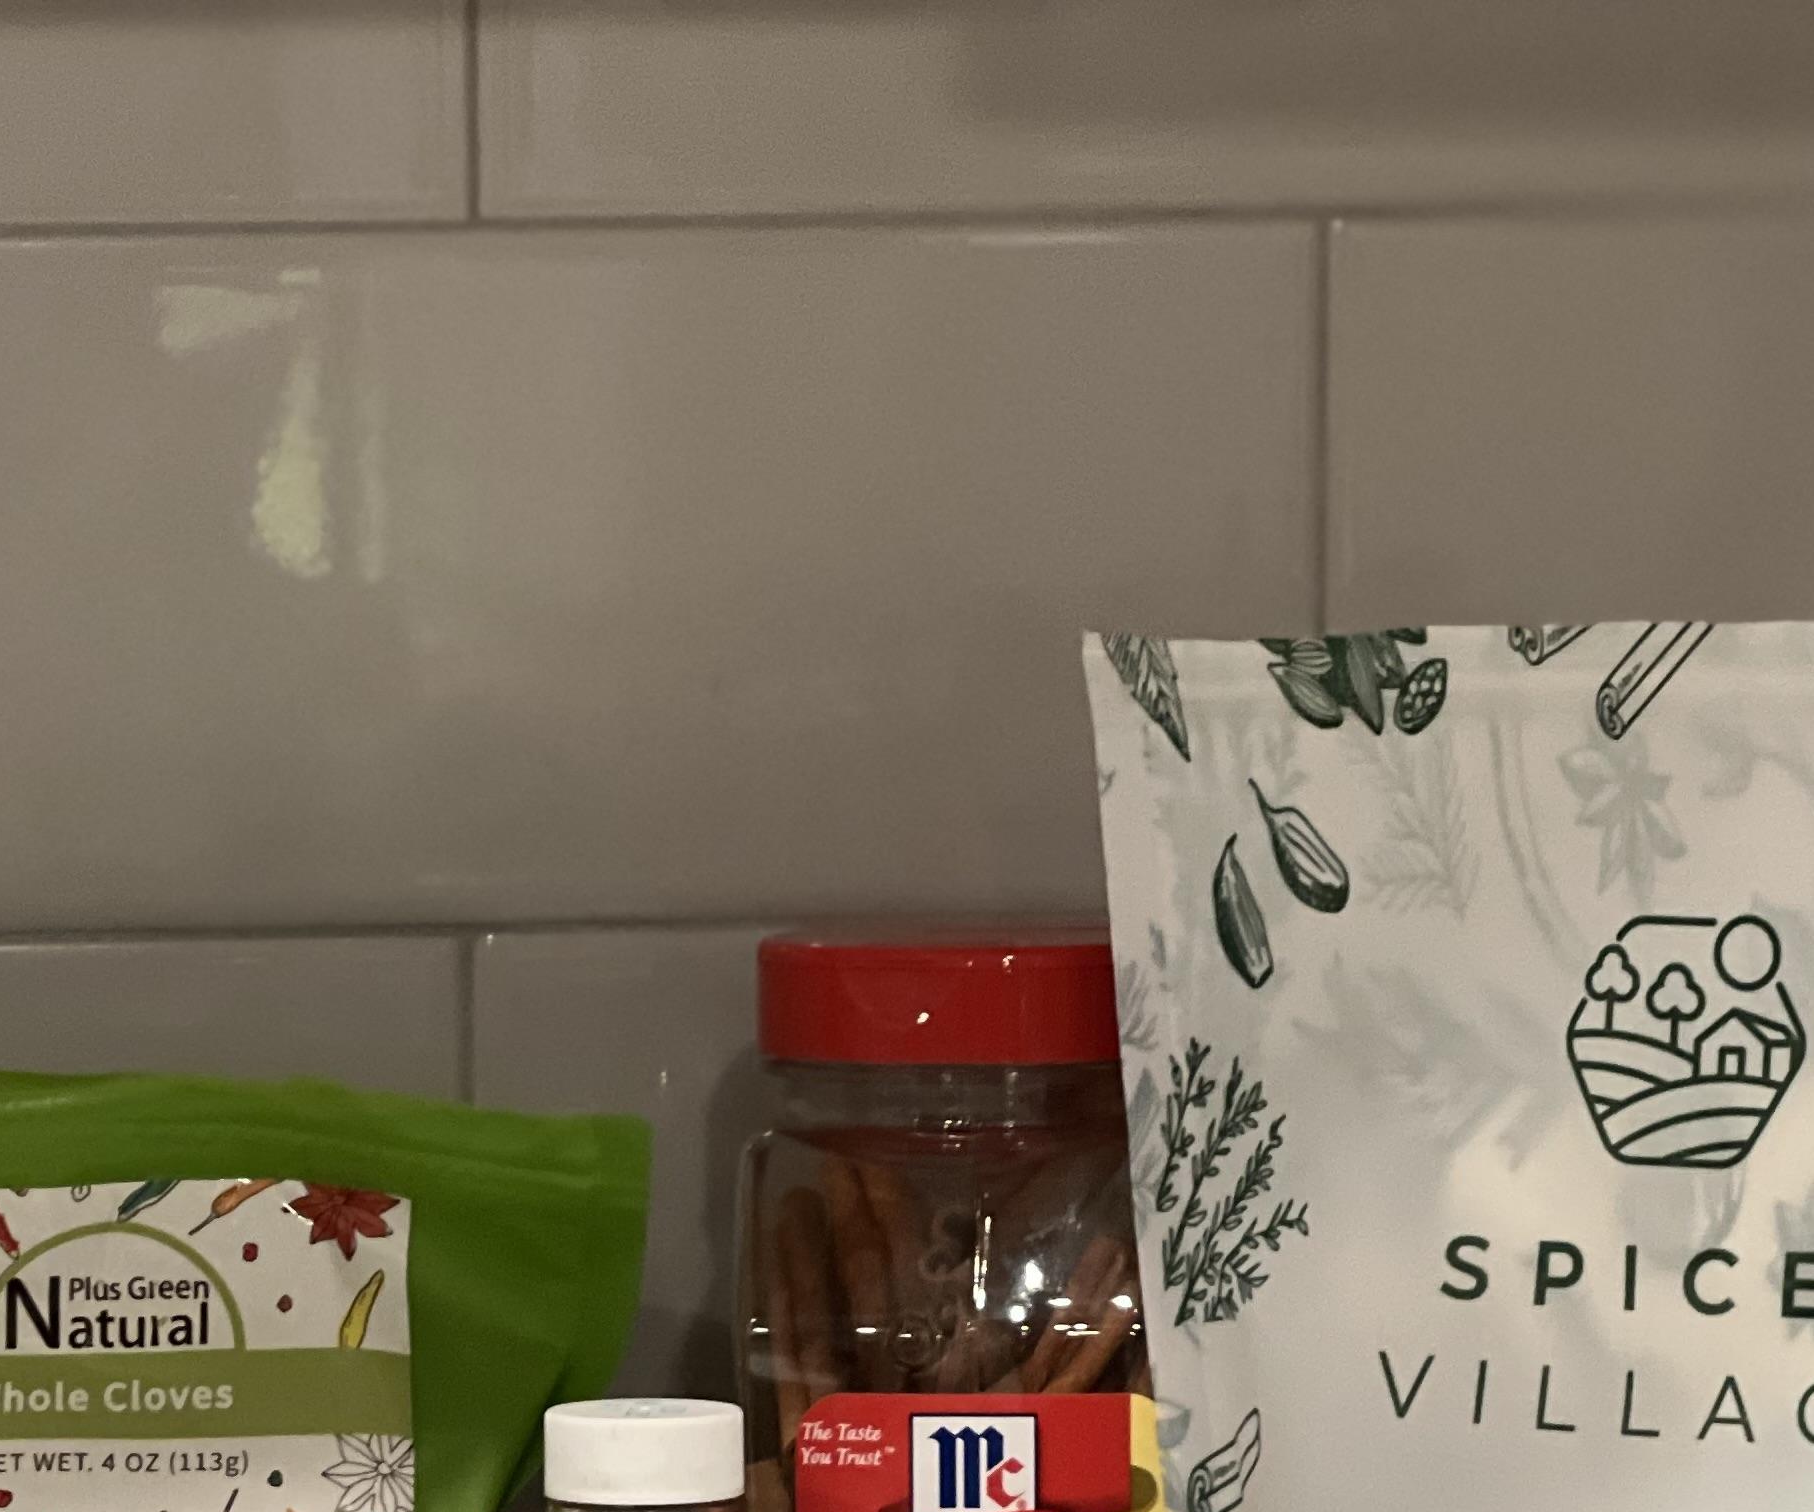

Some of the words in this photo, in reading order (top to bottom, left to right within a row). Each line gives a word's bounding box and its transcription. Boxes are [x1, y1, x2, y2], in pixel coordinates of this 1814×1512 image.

[69, 1277, 121, 1301] Plus
[127, 1276, 210, 1300] Green
[1440, 1235, 1814, 1319] SPICE
[6, 1275, 209, 1349] Natural
[103, 1379, 234, 1412] Cloves
[1378, 1350, 1814, 1445] VILLA
[802, 1421, 833, 1441] The
[837, 1422, 882, 1442] Taste
[33, 1452, 93, 1472] WET.
[101, 1453, 115, 1472] 4
[125, 1452, 160, 1472] OZ
[169, 1450, 249, 1477] (113g)
[801, 1446, 832, 1465] You
